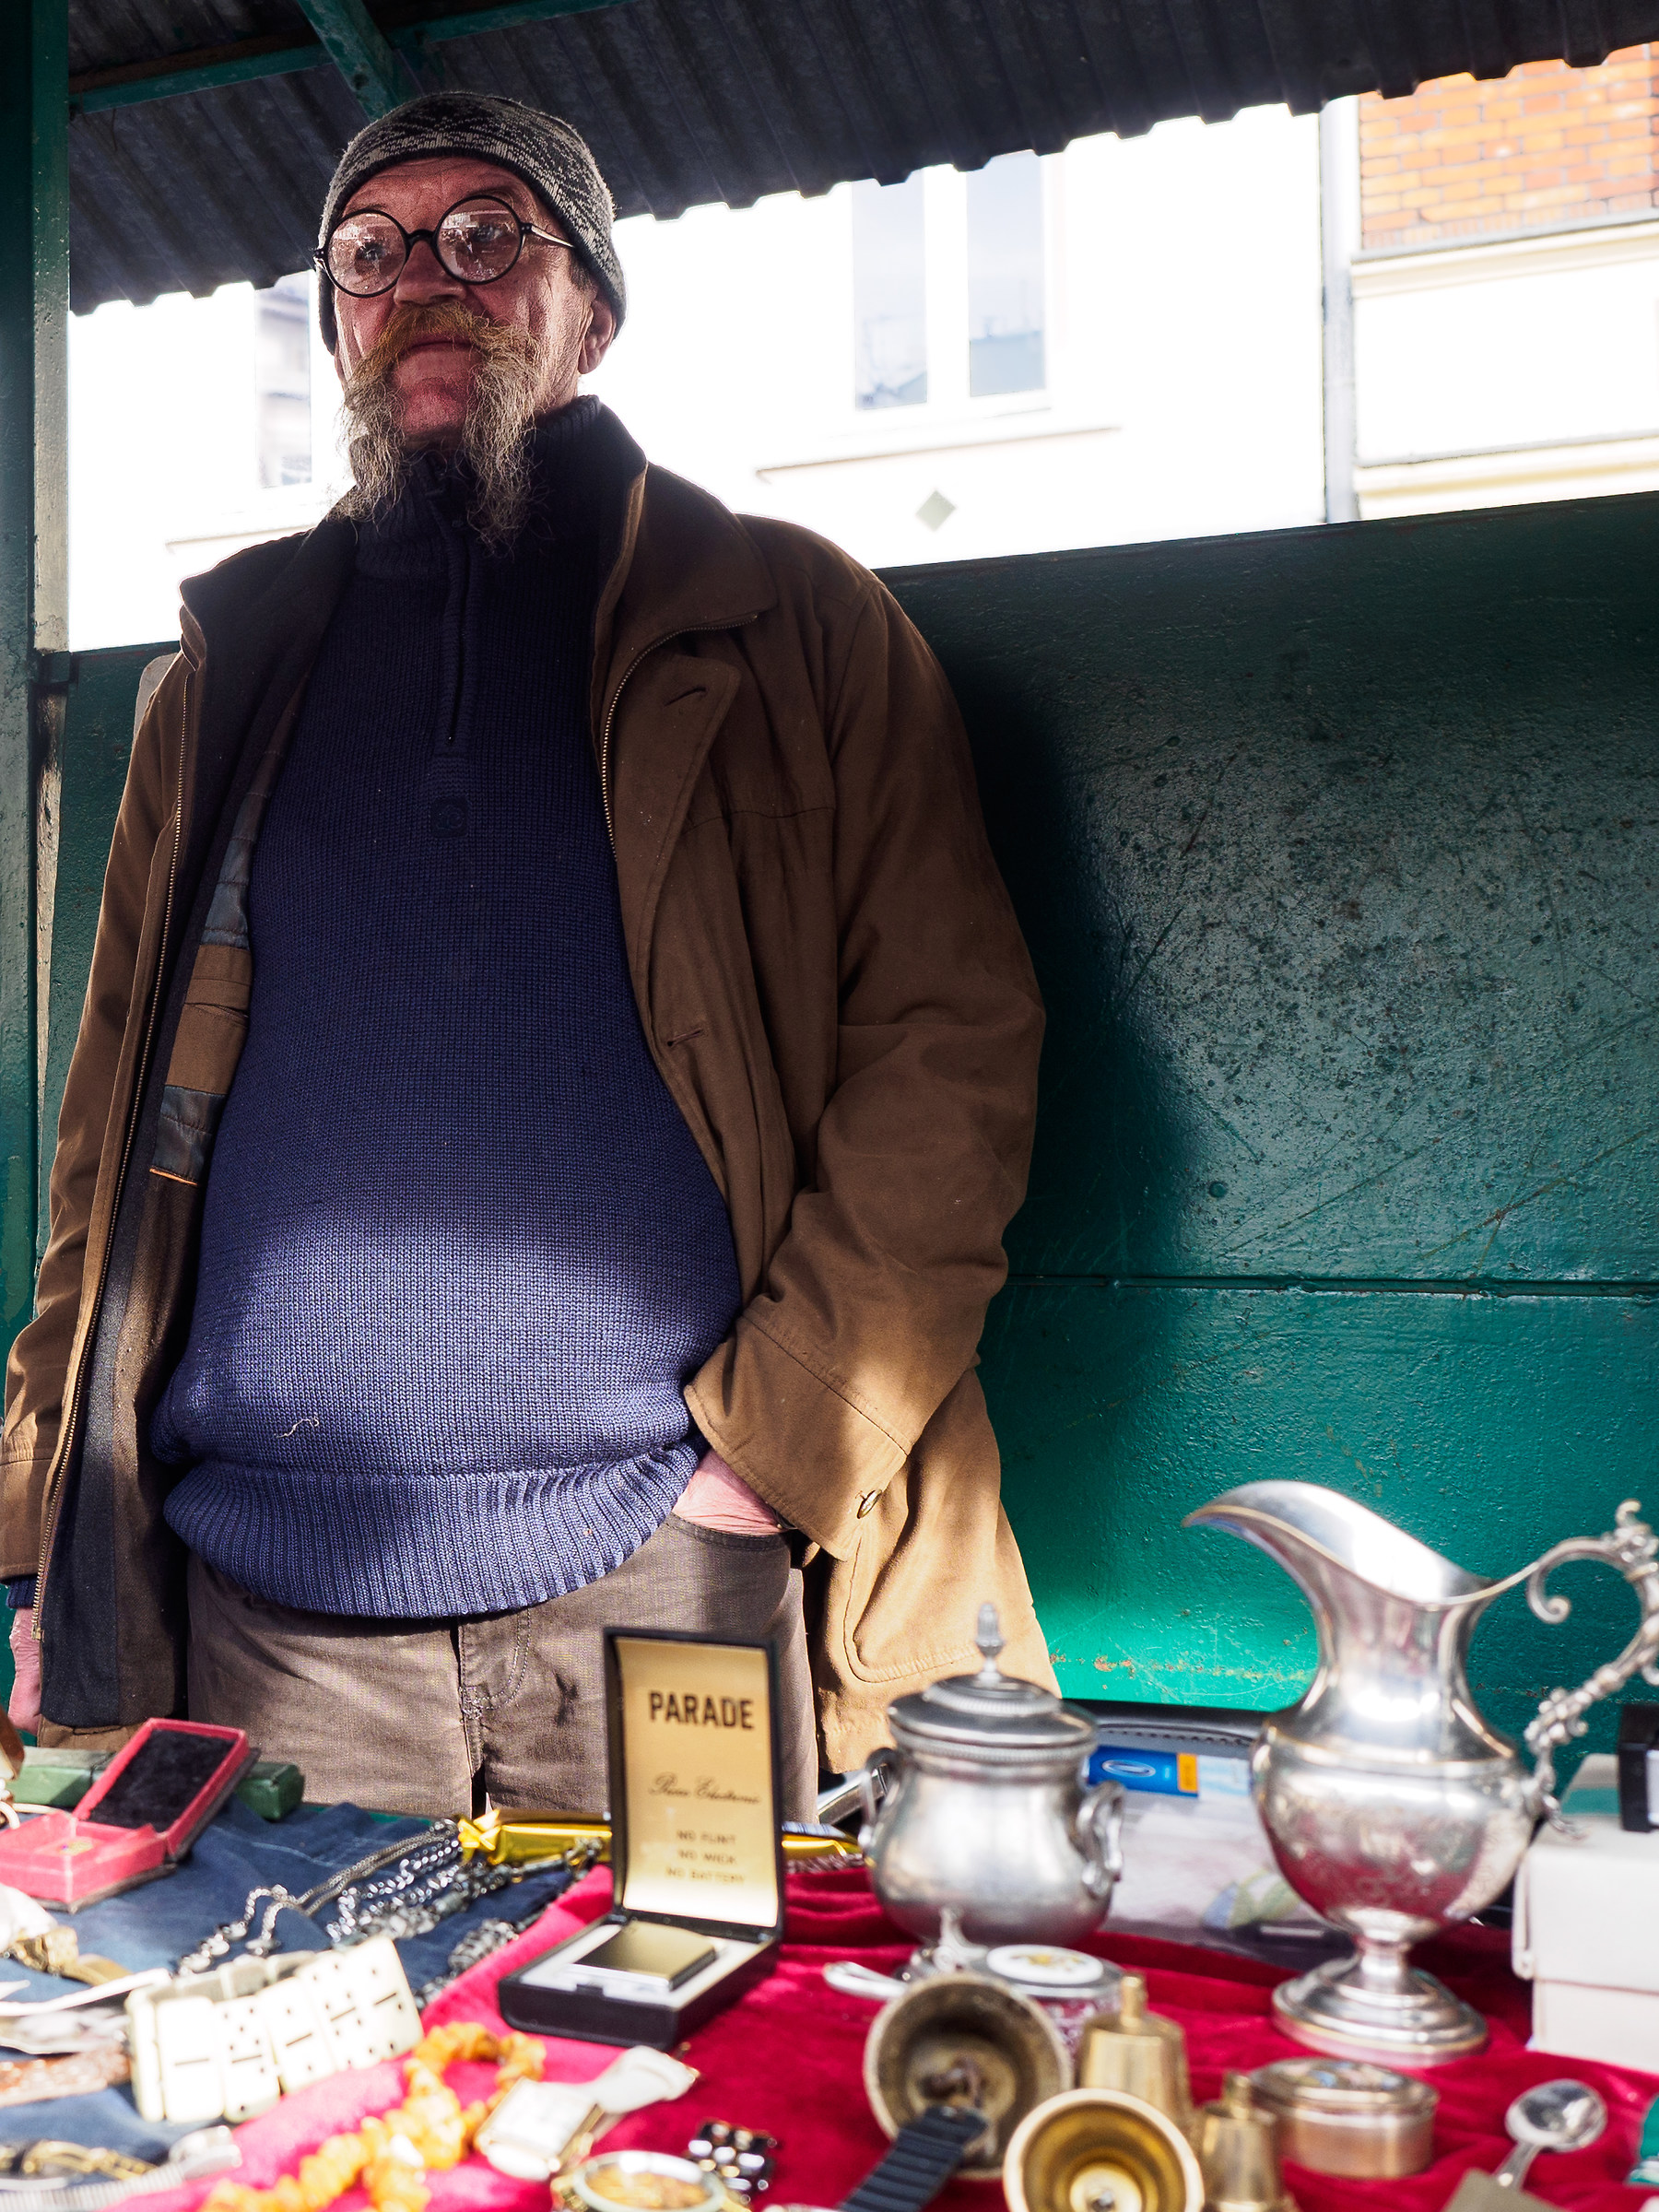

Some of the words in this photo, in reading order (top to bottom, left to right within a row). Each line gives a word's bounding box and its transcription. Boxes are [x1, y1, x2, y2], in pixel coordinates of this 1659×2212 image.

[649, 1690, 755, 1730] PARADE
[676, 1830, 696, 1842] NO
[677, 1848, 698, 1861] NO
